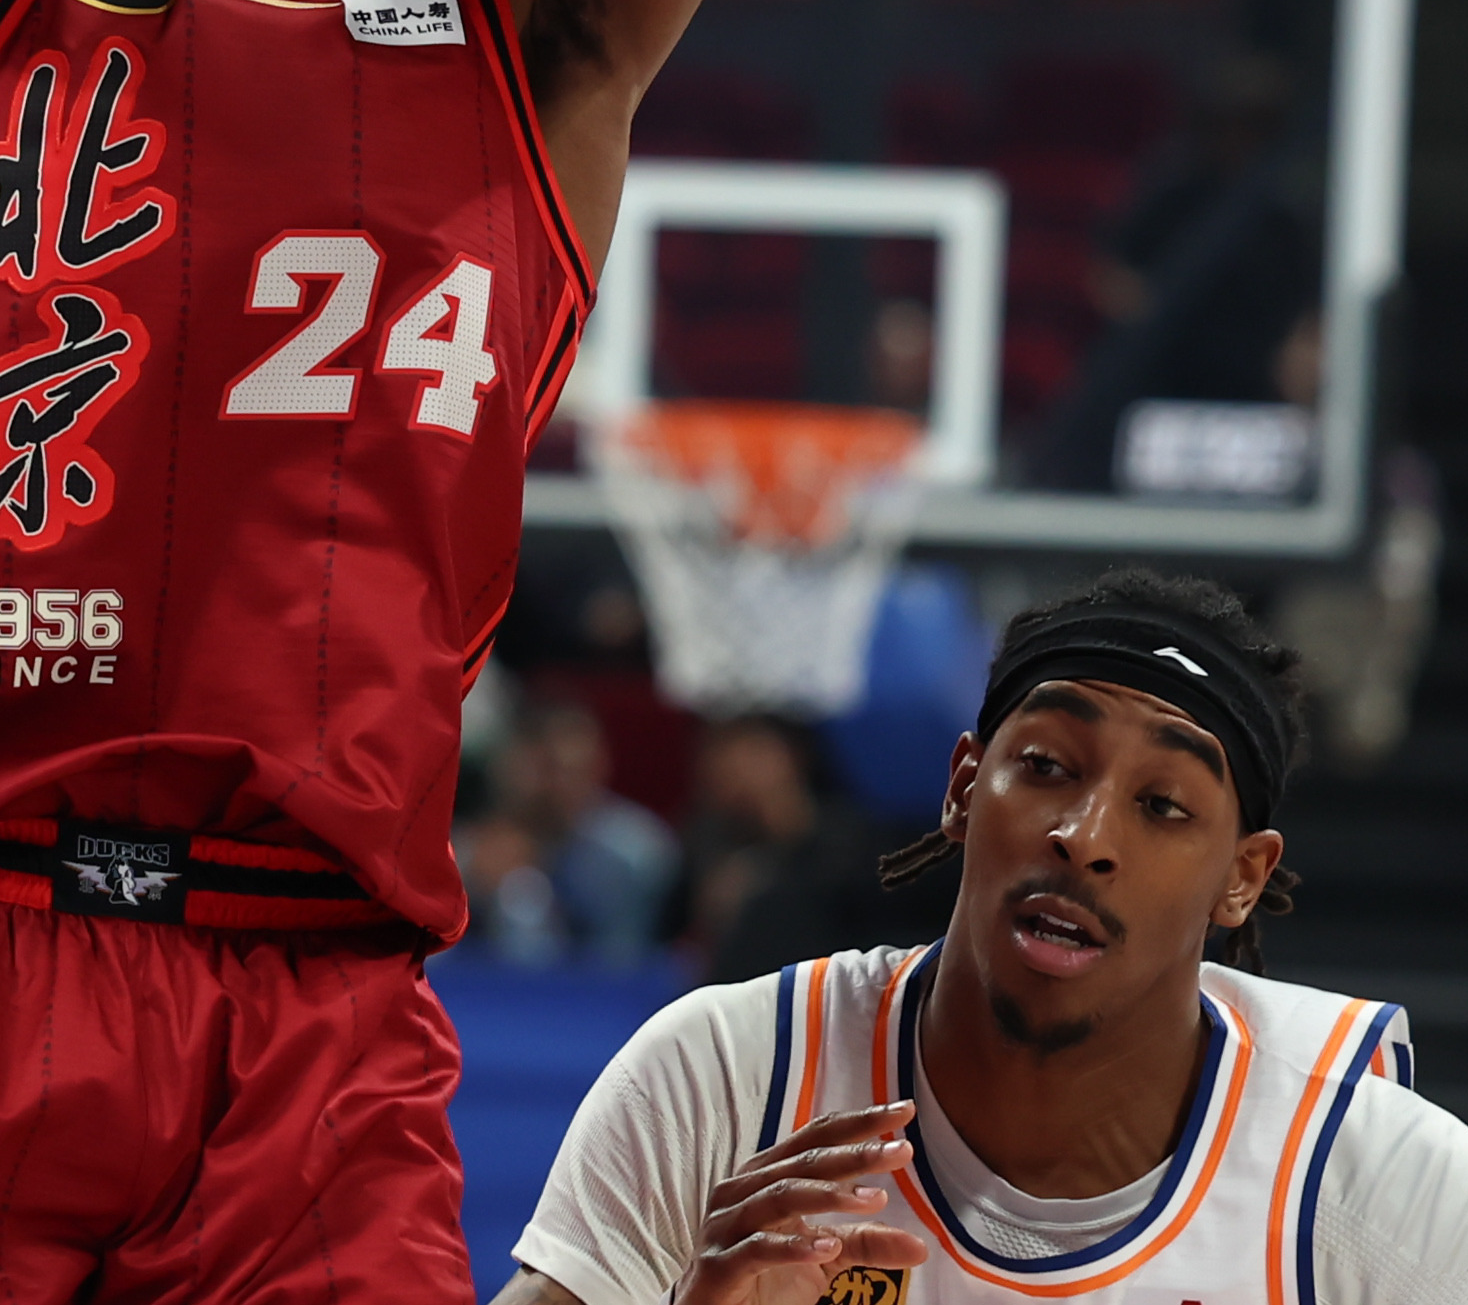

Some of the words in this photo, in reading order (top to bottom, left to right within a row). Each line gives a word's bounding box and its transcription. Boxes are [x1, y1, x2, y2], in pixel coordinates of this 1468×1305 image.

[352, 2, 451, 25] 中国人寿
[359, 25, 412, 37] CHINA
[417, 22, 453, 34] LIFE
[220, 229, 500, 444] 24
[77, 835, 171, 867] DUCKS
